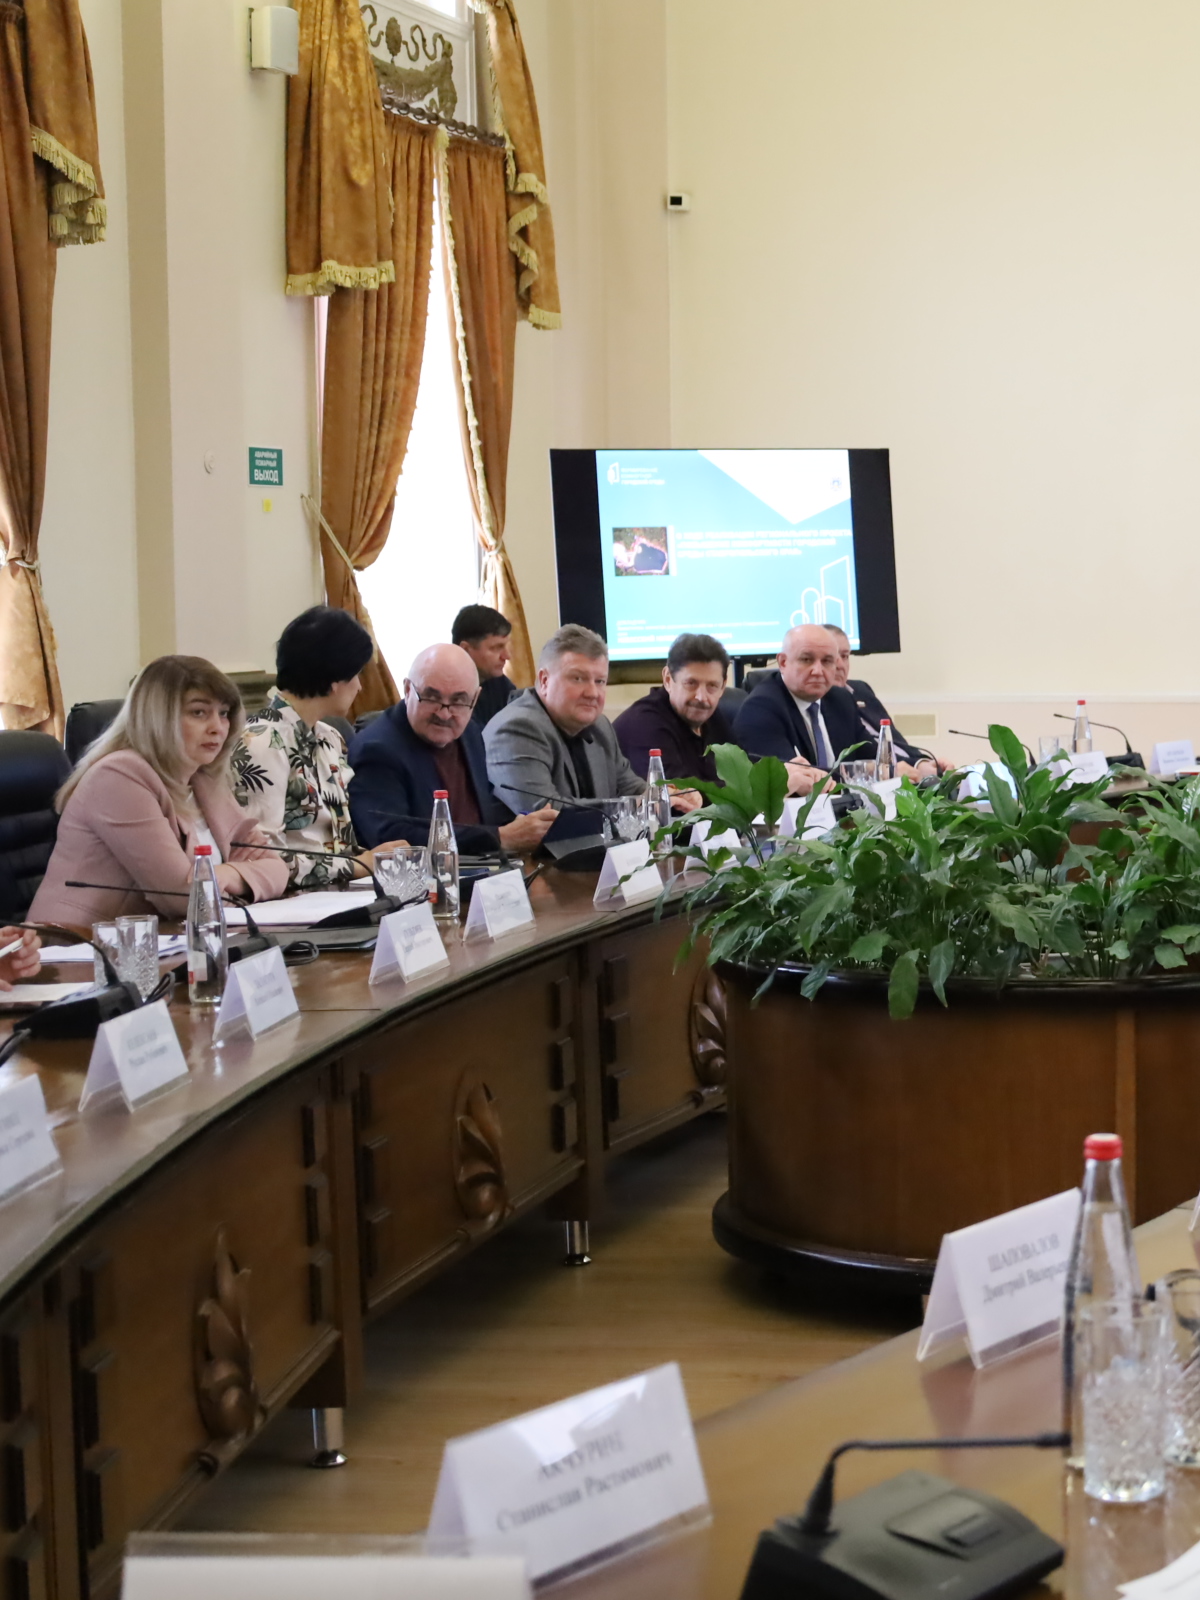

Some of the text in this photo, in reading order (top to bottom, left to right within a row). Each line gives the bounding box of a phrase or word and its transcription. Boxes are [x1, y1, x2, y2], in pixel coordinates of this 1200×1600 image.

[254, 469, 279, 483] ВЫХОД
[988, 1233, 1060, 1273] ШАПОВАЛОВ
[983, 1272, 1026, 1305] Дмитрий
[496, 1488, 582, 1534] Станислав
